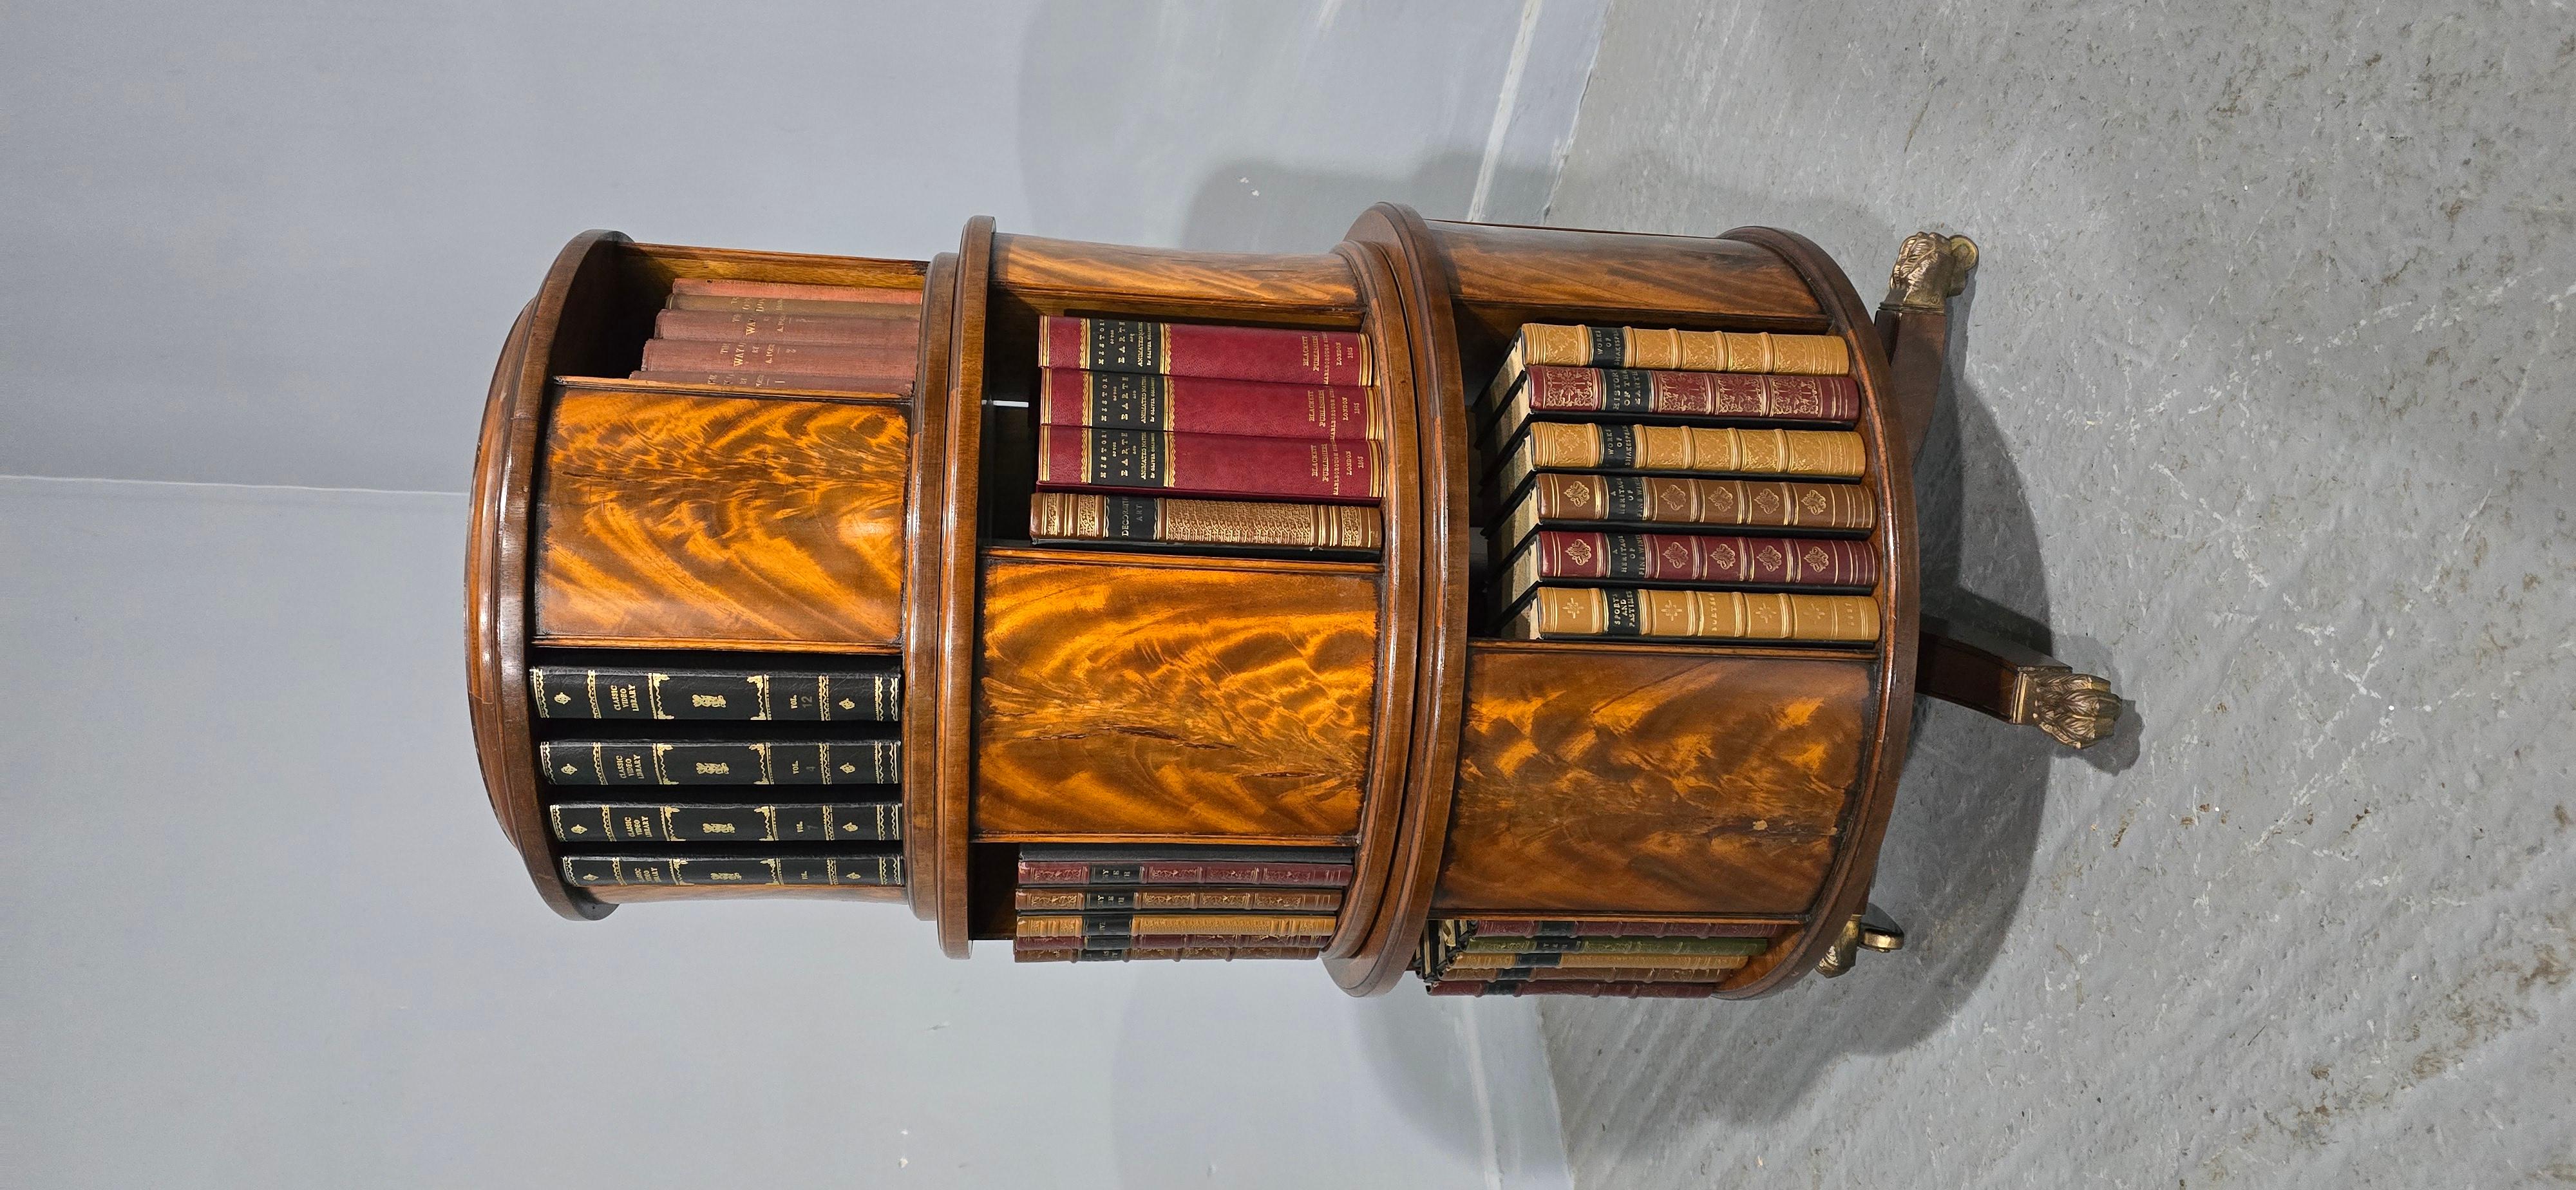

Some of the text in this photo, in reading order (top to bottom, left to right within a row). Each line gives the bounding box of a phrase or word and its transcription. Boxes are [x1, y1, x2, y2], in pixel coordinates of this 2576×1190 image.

[1605, 337, 1612, 347] OF
[734, 348, 744, 366] WAY
[1121, 377, 1129, 420] EARTH
[1624, 391, 1631, 406] OF
[1616, 437, 1623, 448] OF
[1627, 489, 1634, 501] OF
[1629, 547, 1636, 559] OF
[1612, 594, 1621, 625] SPORTS
[611, 685, 621, 710] CLASSIC
[620, 688, 629, 707] VIDEO
[628, 685, 639, 711] LIBRARY
[800, 695, 813, 707] 12
[616, 755, 627, 778] CLASSIC
[625, 759, 634, 776] VIDEO
[633, 754, 645, 779] LIBRARY
[625, 817, 635, 836] CLASSIC
[634, 819, 643, 835] VIDEO
